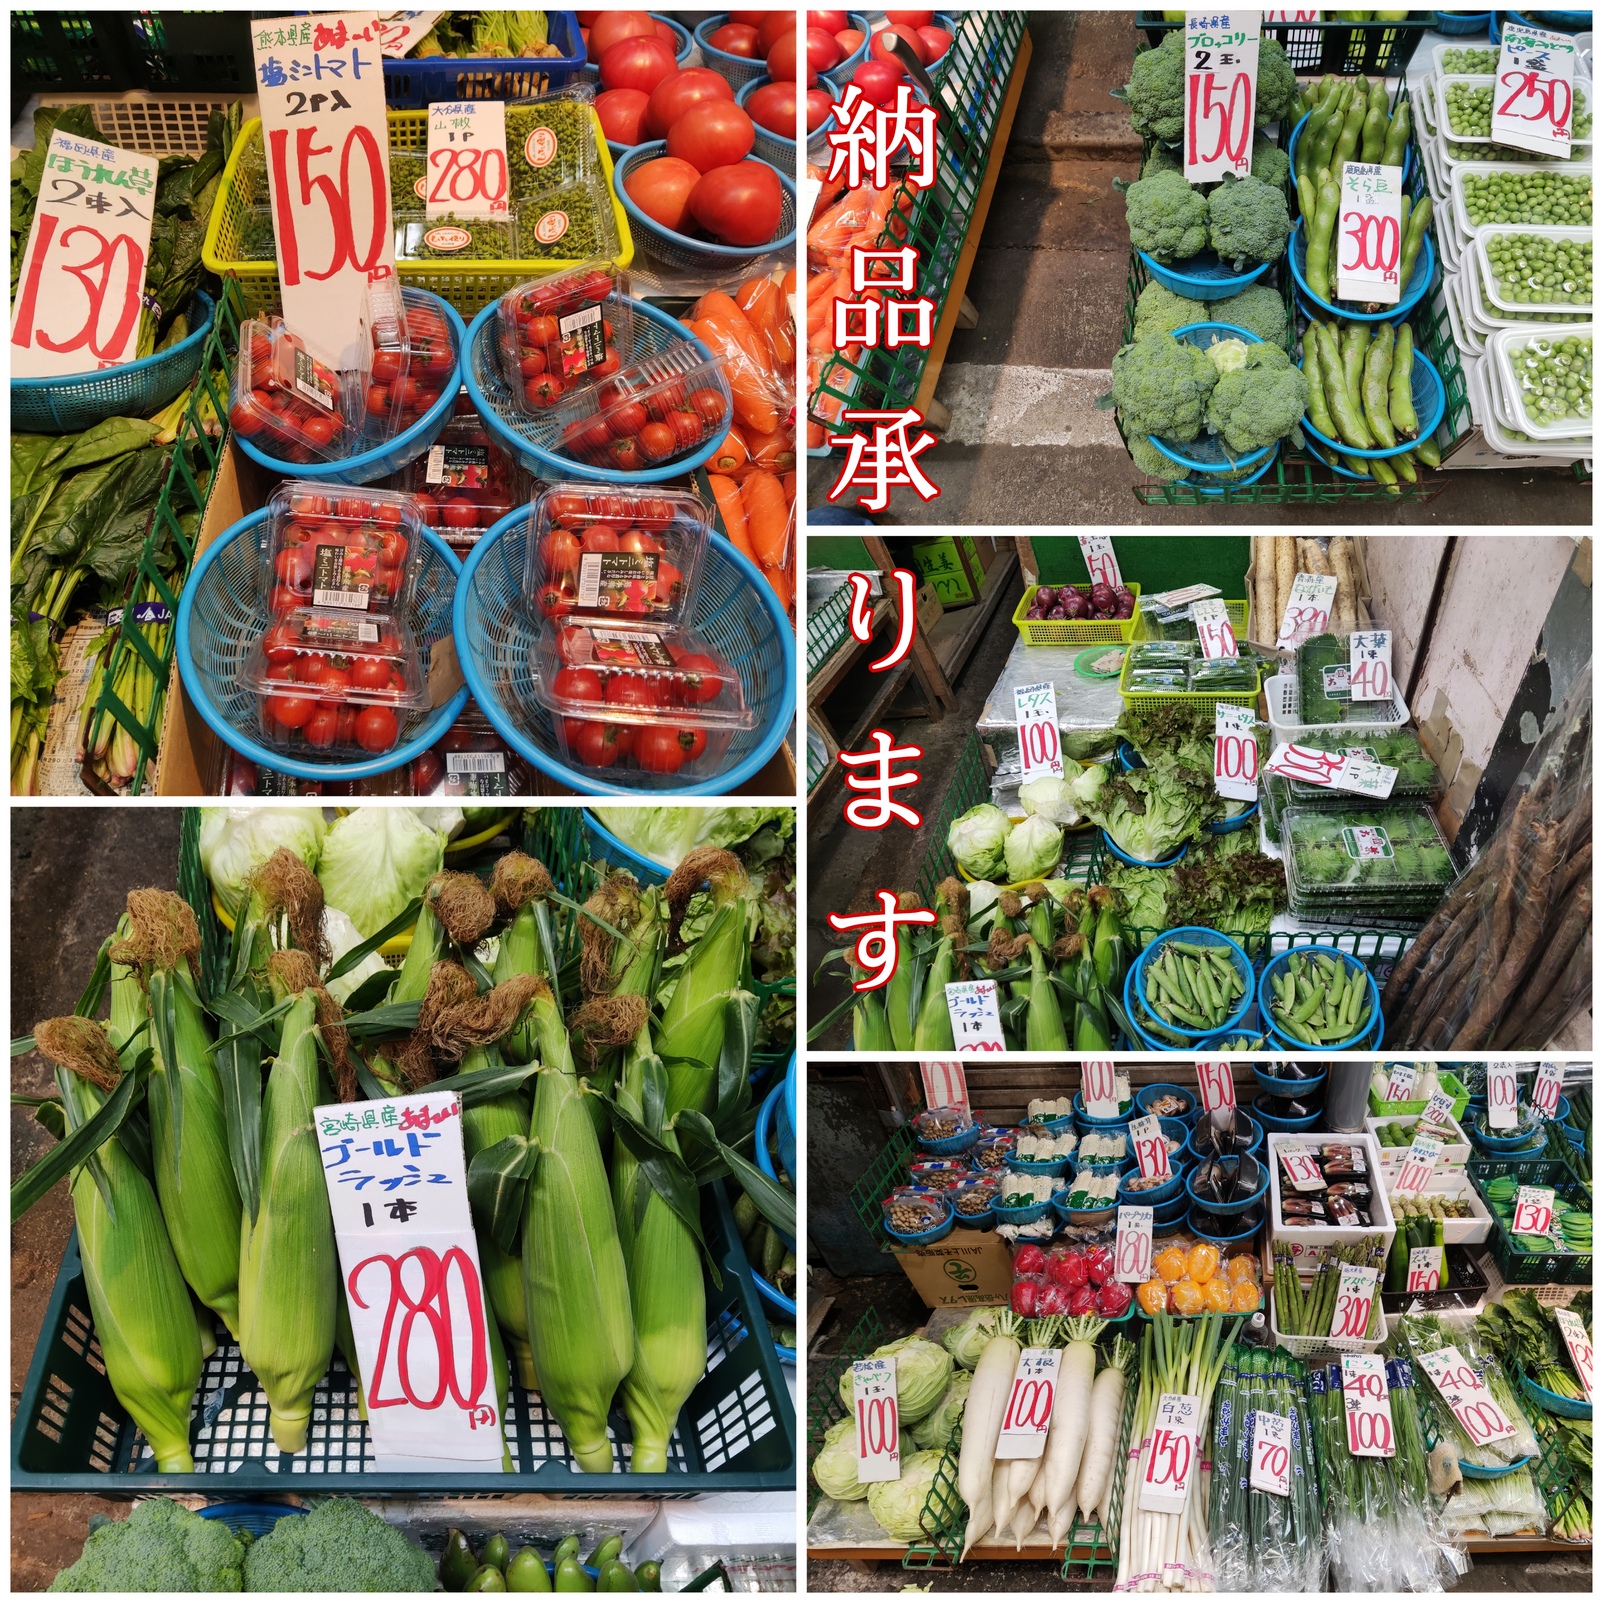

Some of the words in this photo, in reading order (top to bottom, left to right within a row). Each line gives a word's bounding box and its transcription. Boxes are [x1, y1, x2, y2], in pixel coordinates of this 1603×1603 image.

[254, 22, 312, 50] 熊本県産
[1187, 32, 1259, 48] ブロッコリー
[1188, 15, 1231, 30] 長崎県産
[258, 47, 372, 87] 塩ミニトマト
[285, 89, 352, 117] 2P入
[432, 104, 476, 116] 大分県産
[1497, 71, 1571, 128] 250
[1188, 72, 1252, 166] 150
[53, 137, 116, 163] 福岡県産
[48, 153, 154, 195] ほうれん草
[429, 149, 508, 203] 280
[1346, 176, 1392, 194] そら豆
[45, 179, 151, 221] 2束入
[269, 125, 388, 286] 150
[1343, 211, 1400, 271] 300
[11, 212, 144, 360] 130
[319, 548, 332, 590] 塩ミニトマト
[602, 556, 655, 568] 塩ミニトマト
[1198, 619, 1238, 658] 150
[1353, 632, 1388, 649] 大葉
[1350, 660, 1389, 698] 40
[1017, 692, 1053, 708] レタス
[1020, 720, 1057, 769] 100
[1216, 735, 1258, 781] 100
[948, 995, 990, 1008] ゴールド
[953, 1007, 994, 1018] ラッシュ
[963, 1021, 983, 1032] 1本
[1197, 1062, 1234, 1113] 150
[1489, 1075, 1517, 1107] 100
[1533, 1077, 1561, 1110] 100
[320, 1104, 401, 1136] 宮崎県産
[322, 1132, 442, 1169] ゴールド
[1135, 1136, 1168, 1178] 130
[337, 1164, 453, 1191] ラッシュ
[1281, 1155, 1322, 1183] 130
[363, 1197, 418, 1228] 1本
[1119, 1210, 1153, 1221] パプリカ
[1514, 1203, 1551, 1231] 130
[1115, 1230, 1150, 1275] 180
[1409, 1269, 1440, 1292] 150
[347, 1245, 489, 1411] 280
[1331, 1294, 1371, 1338] 300
[854, 1371, 892, 1386] きゃべつ
[1021, 1357, 1055, 1368] 大根
[1439, 1366, 1477, 1390] 40
[1344, 1373, 1384, 1398] 40
[1003, 1378, 1053, 1430] 100
[858, 1396, 897, 1458] 100
[1348, 1411, 1391, 1452] 100
[1455, 1401, 1504, 1445] 100
[1145, 1428, 1191, 1484] 150
[1258, 1440, 1289, 1477] 70
